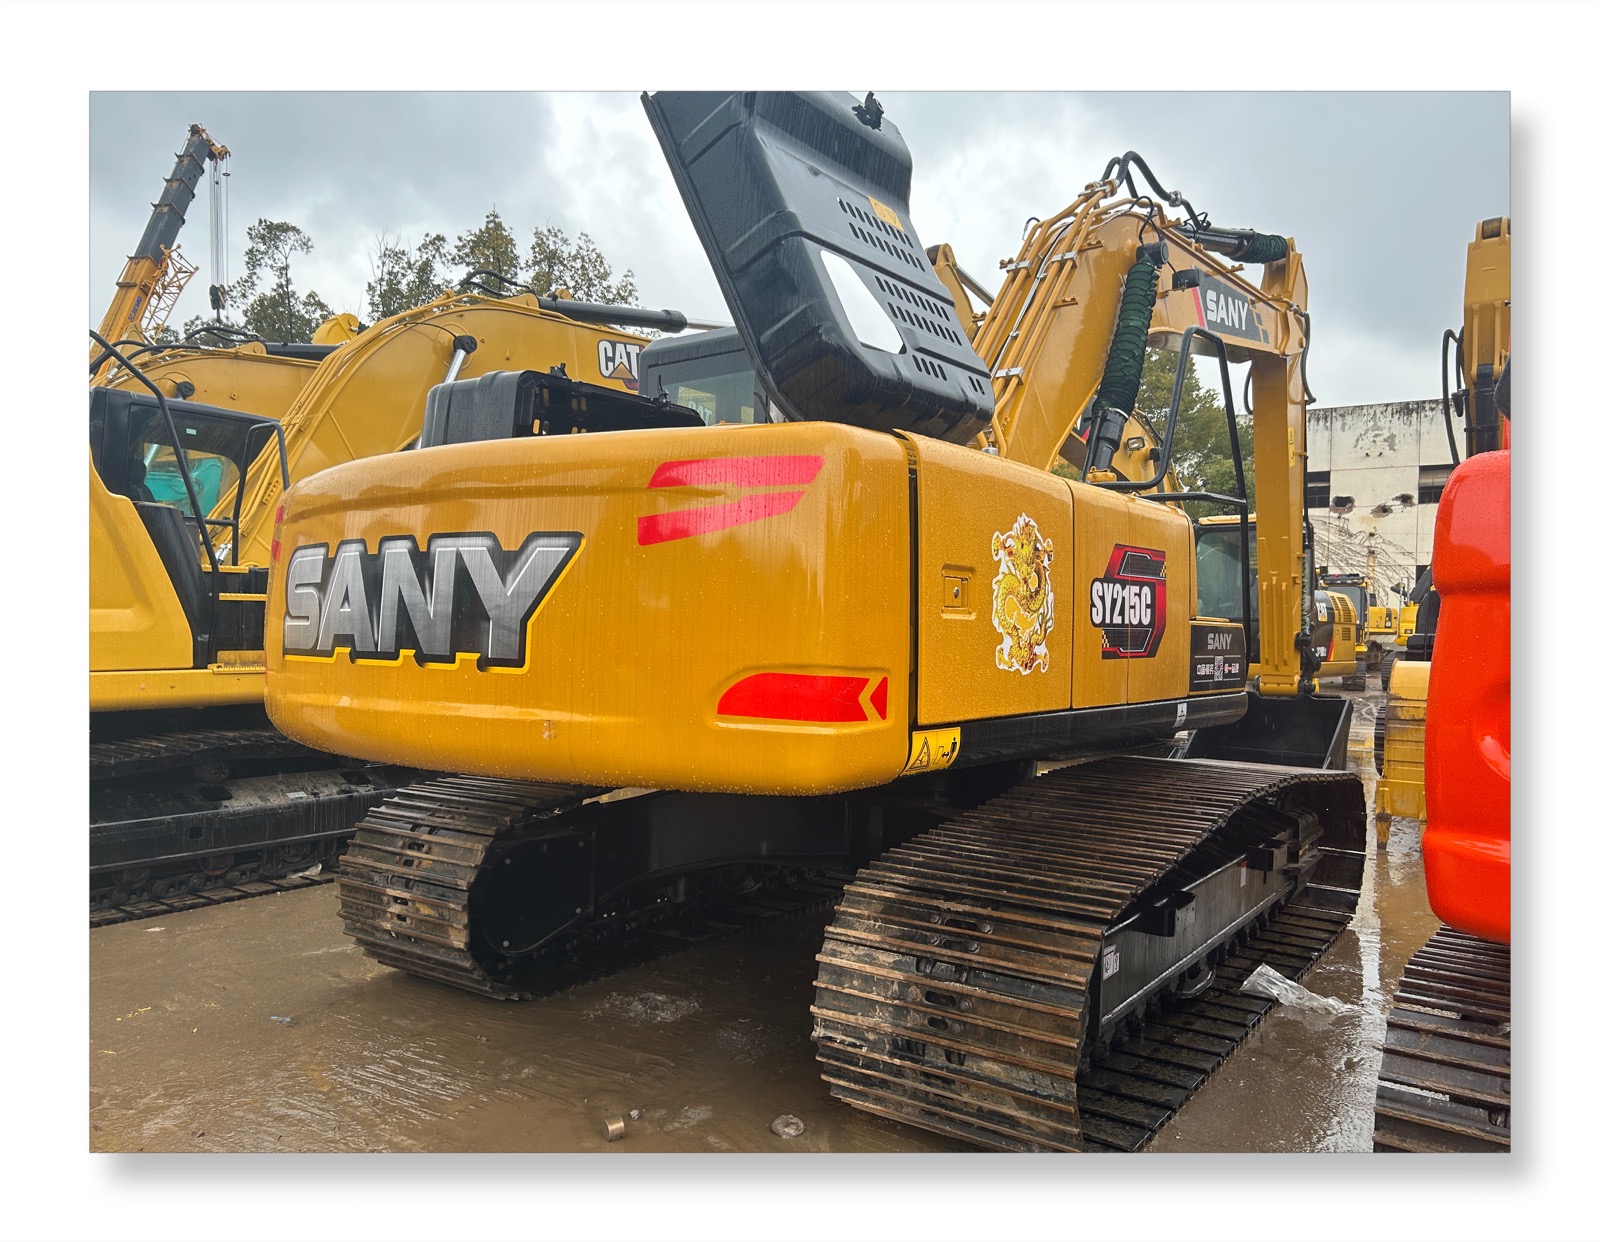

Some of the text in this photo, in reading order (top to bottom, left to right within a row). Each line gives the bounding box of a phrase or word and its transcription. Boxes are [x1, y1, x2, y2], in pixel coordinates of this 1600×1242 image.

[1206, 289, 1248, 331] SANY
[598, 340, 640, 380] CAT
[284, 534, 582, 667] SANY
[1091, 581, 1152, 625] SY215C
[1207, 633, 1232, 650] SANY
